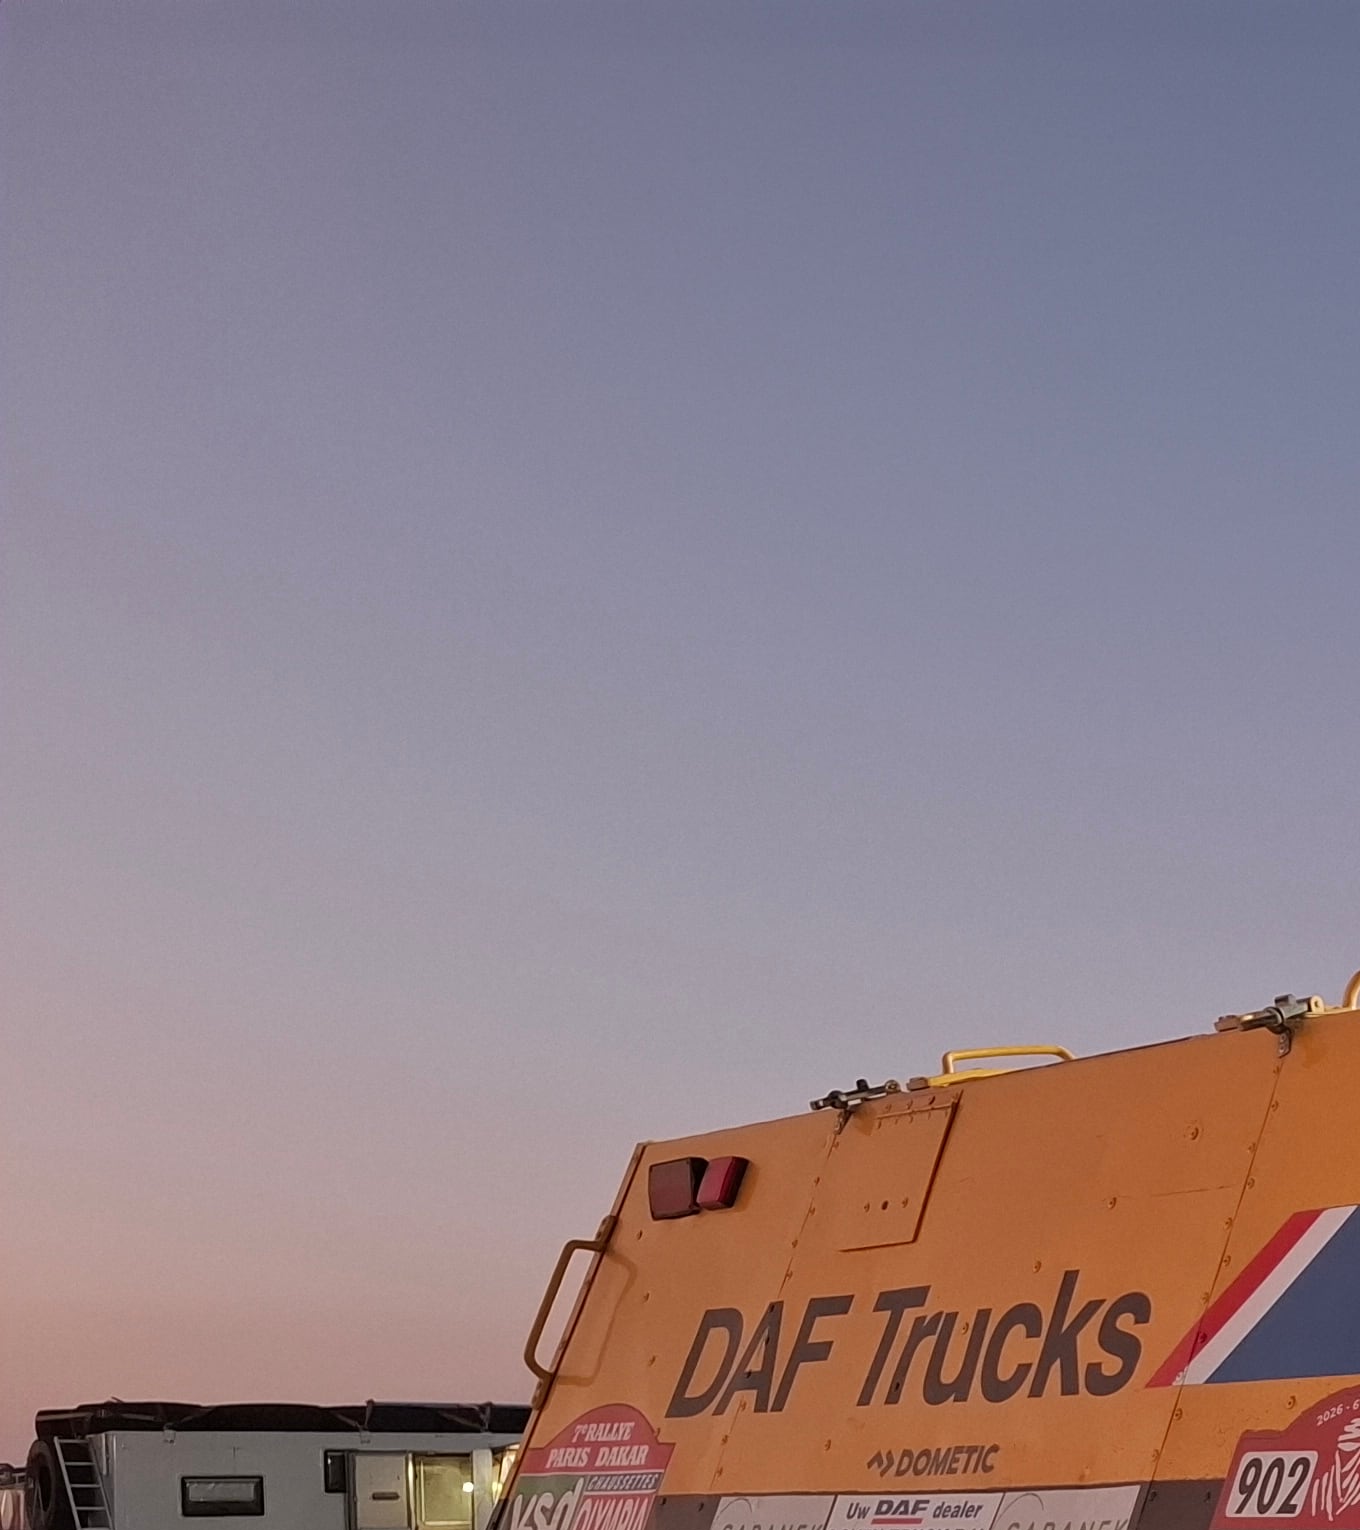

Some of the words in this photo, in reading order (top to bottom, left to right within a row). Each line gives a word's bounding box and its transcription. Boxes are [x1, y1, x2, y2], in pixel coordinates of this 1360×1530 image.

[665, 1294, 855, 1418] DAF
[857, 1269, 1152, 1407] Trucks
[1315, 1403, 1344, 1427] 2026
[585, 1422, 636, 1442] RALLYE
[546, 1447, 591, 1469] PARIS
[594, 1445, 649, 1468] DAKAR
[895, 1443, 1001, 1478] DOMETIC
[587, 1473, 659, 1491] CHAUSSETTES
[1235, 1456, 1312, 1516] 902
[846, 1502, 871, 1520] Uw
[874, 1499, 930, 1516] DAF
[932, 1500, 984, 1519] dealer
